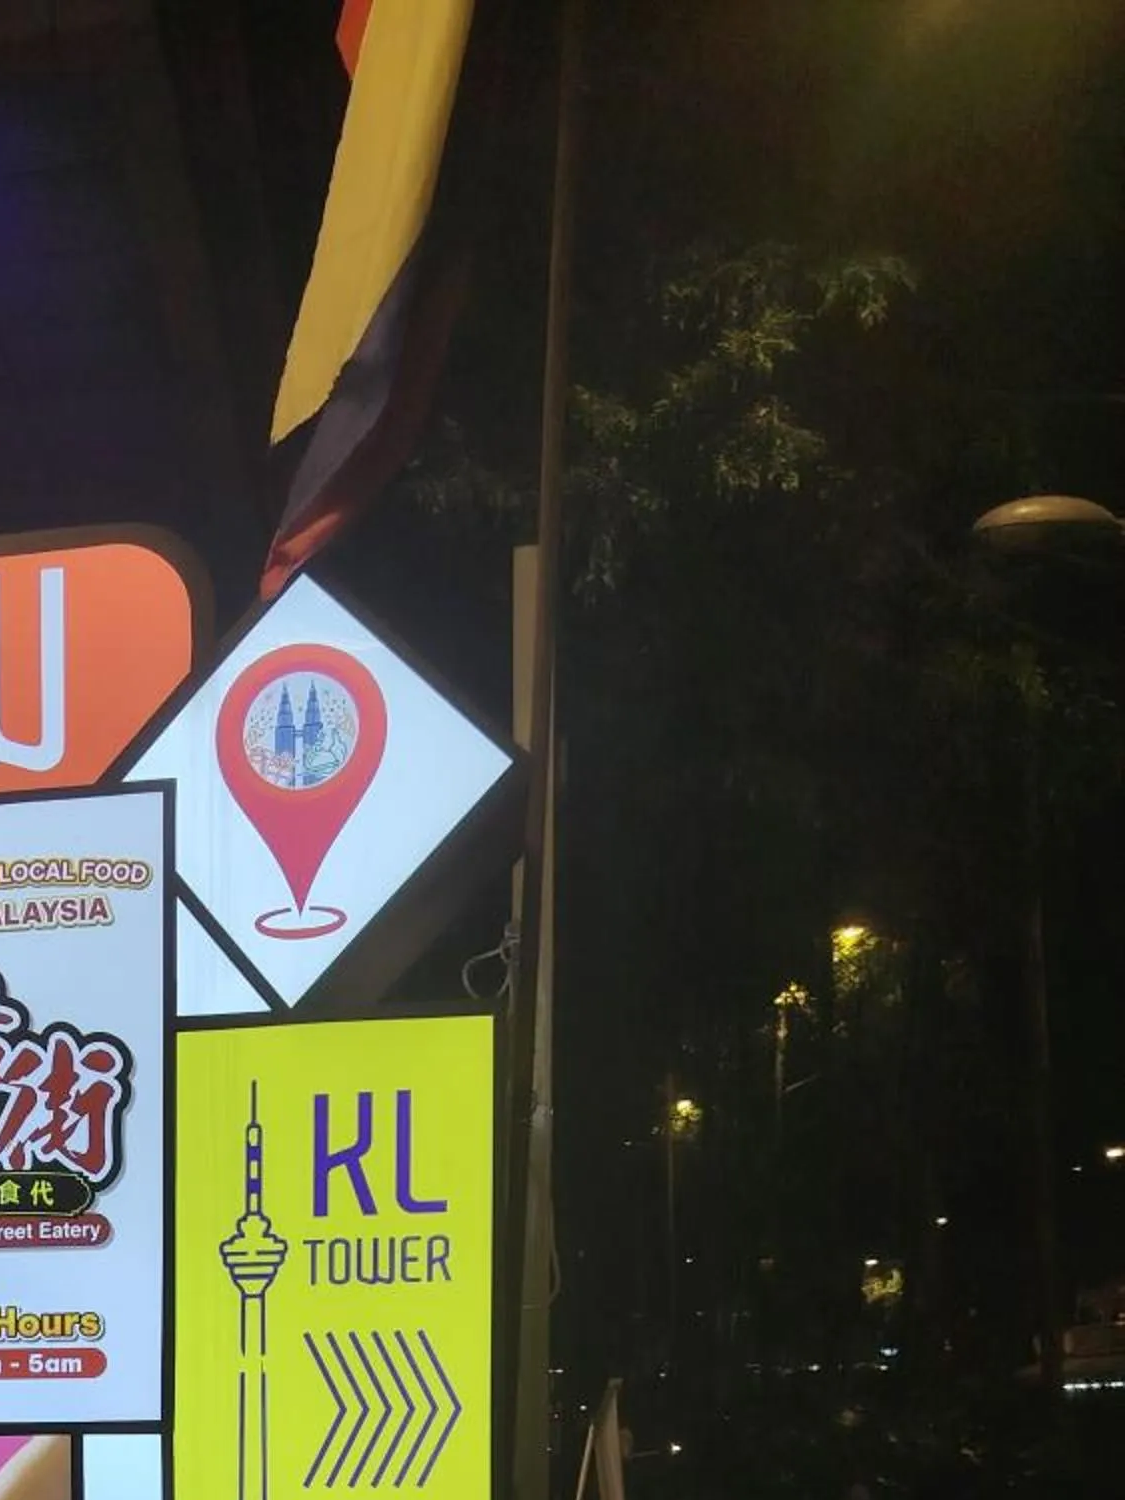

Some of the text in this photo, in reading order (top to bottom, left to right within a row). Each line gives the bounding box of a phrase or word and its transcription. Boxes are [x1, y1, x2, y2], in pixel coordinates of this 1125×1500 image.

[80, 860, 151, 884] FOOD
[313, 1090, 448, 1217] KL
[38, 1221, 101, 1242] Eatery
[303, 1235, 452, 1286] TOWER
[27, 1353, 83, 1374] 5am
